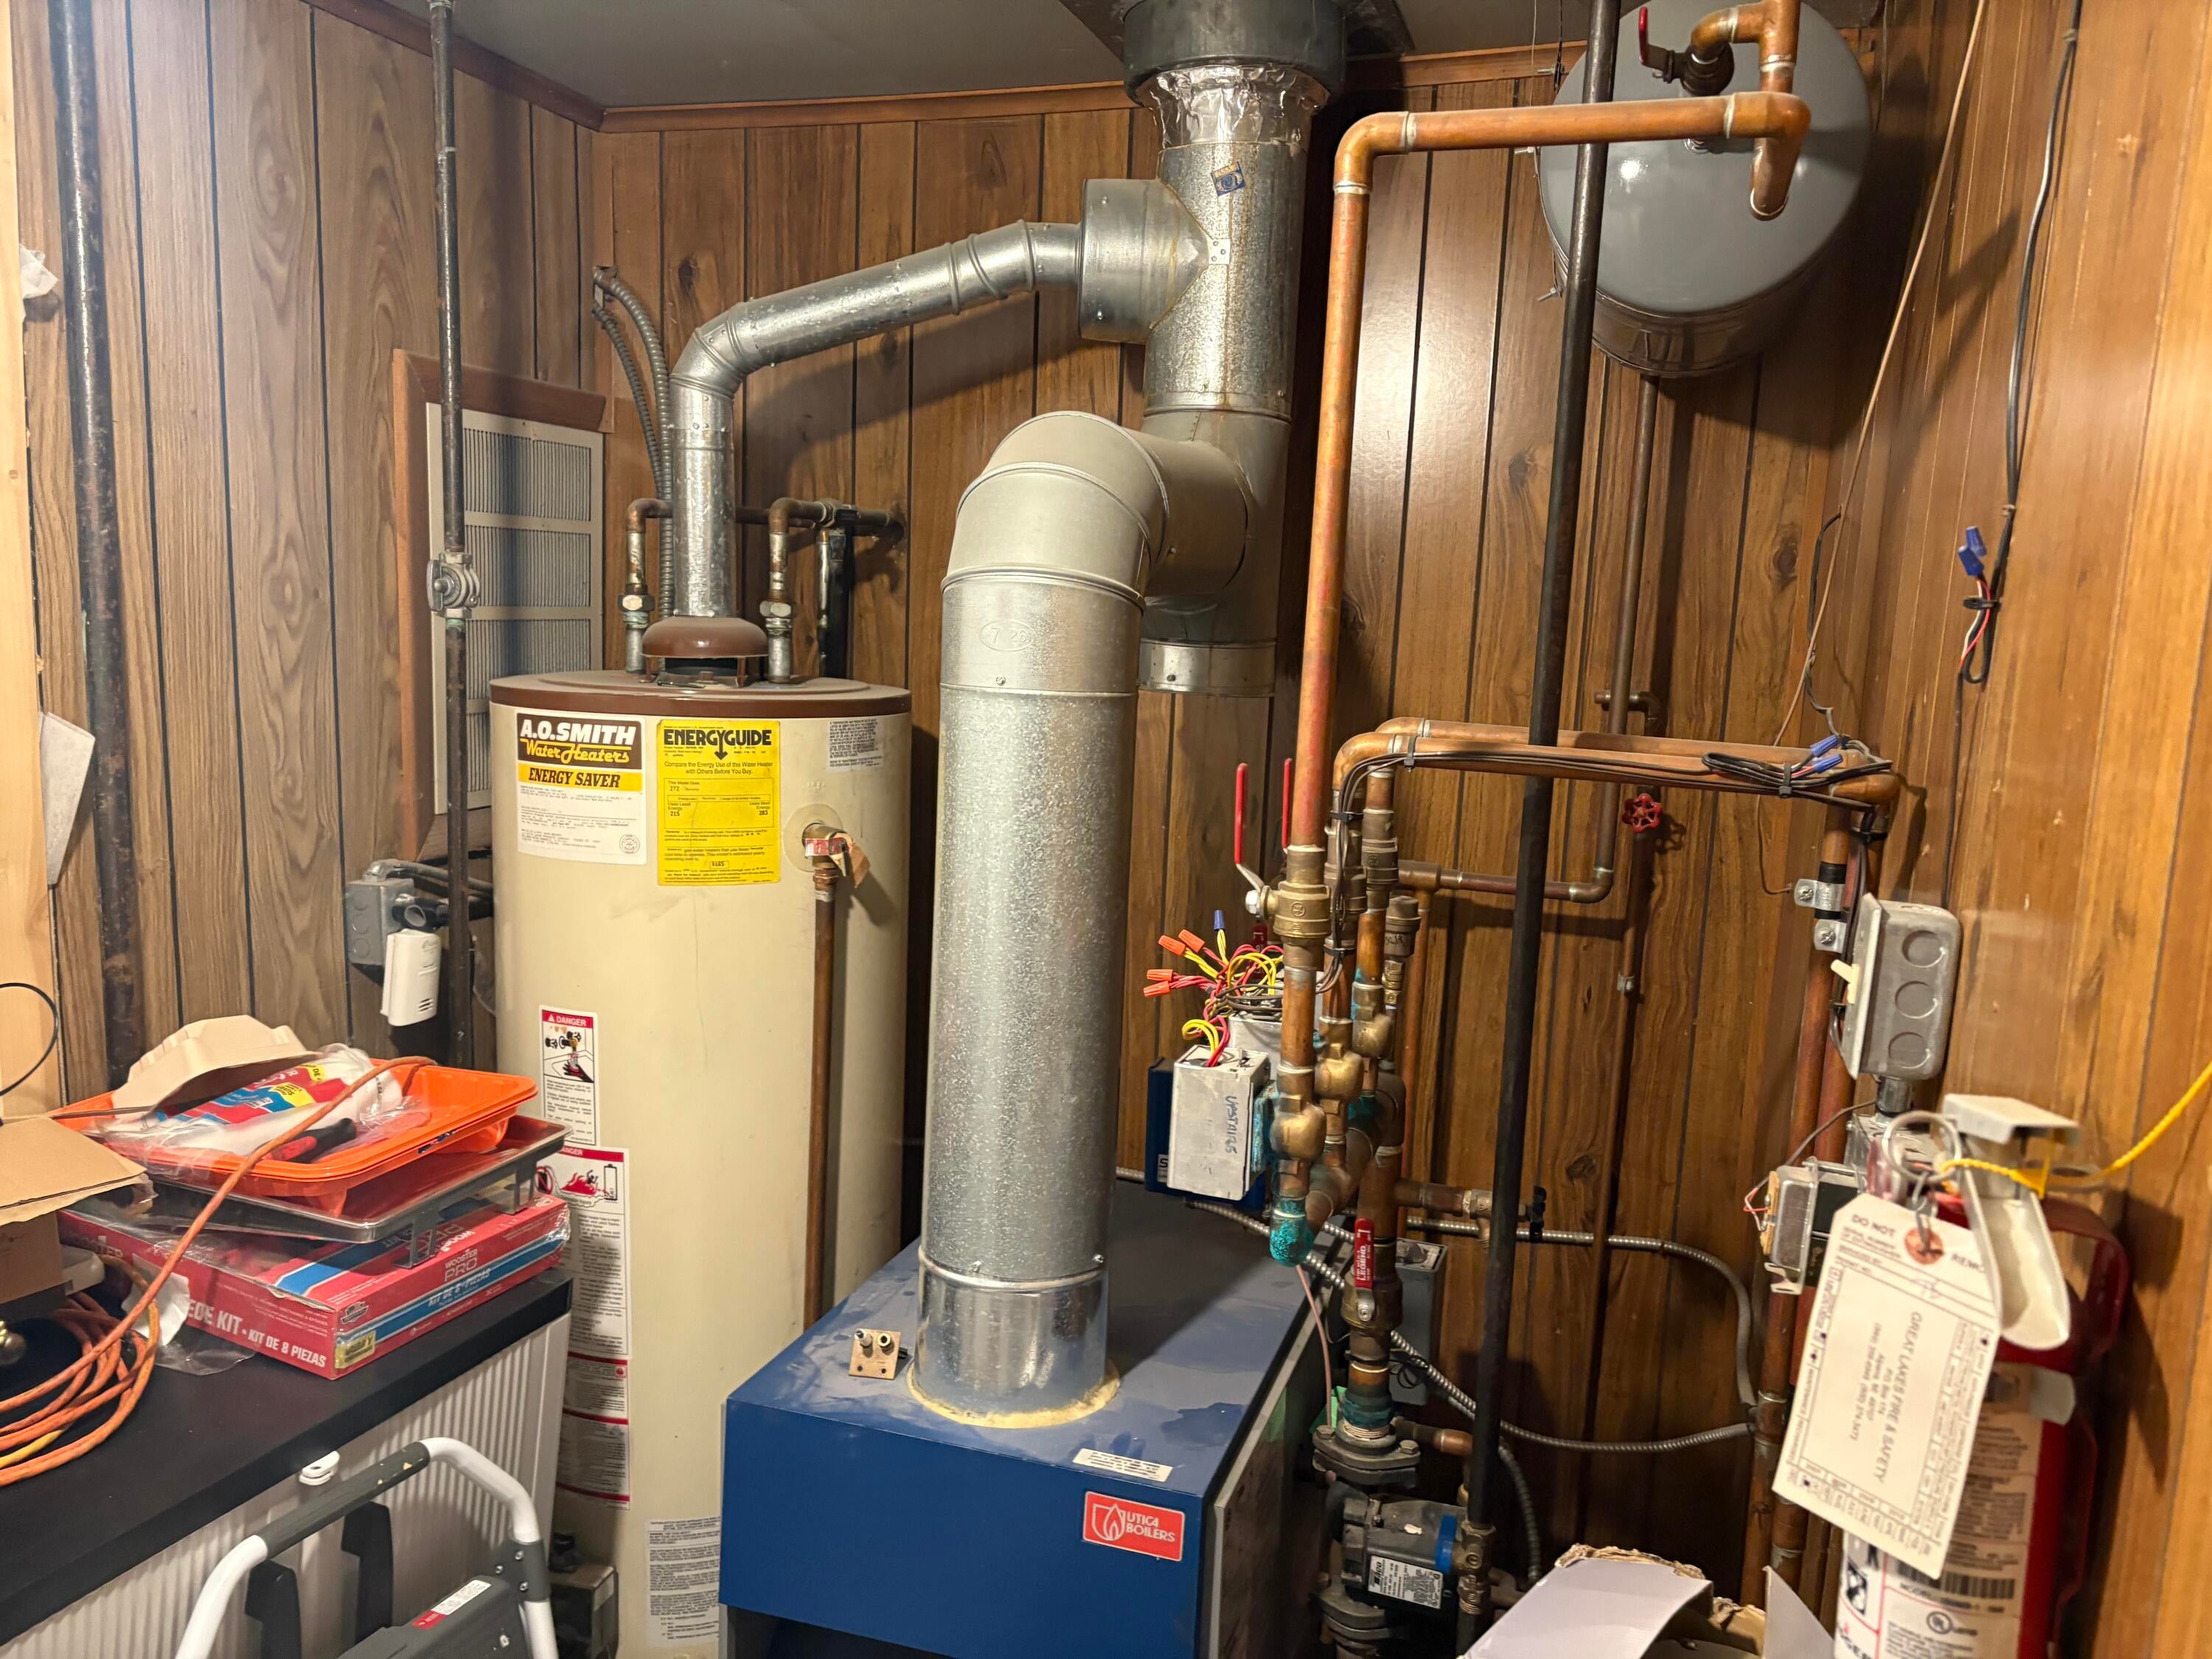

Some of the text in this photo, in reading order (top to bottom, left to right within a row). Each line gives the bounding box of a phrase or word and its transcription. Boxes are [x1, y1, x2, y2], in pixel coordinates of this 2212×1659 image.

[664, 729, 772, 746] ENERGYGUIDE
[520, 738, 632, 765] Water Heaters
[528, 767, 621, 788] ENERGY SAVER
[556, 1015, 586, 1026] DANGER
[1225, 1095, 1239, 1155] UPSTAIRS
[560, 1147, 583, 1156] ANGER
[1871, 1222, 1896, 1238] NOT
[444, 1257, 478, 1282] PRO
[445, 1248, 478, 1269] WOOSTER
[216, 1310, 243, 1335] KIT
[248, 1329, 265, 1344] KIT
[265, 1335, 279, 1351] DE
[282, 1341, 289, 1354] 8
[291, 1344, 327, 1368] PIEZAS
[1902, 1311, 1923, 1354] GREAT
[1893, 1354, 1911, 1394] LAKES
[1886, 1394, 1904, 1424] FIRE
[1874, 1434, 1895, 1484] SAFETY
[1127, 1512, 1159, 1528] UTICA
[1125, 1525, 1176, 1543] BOILERS
